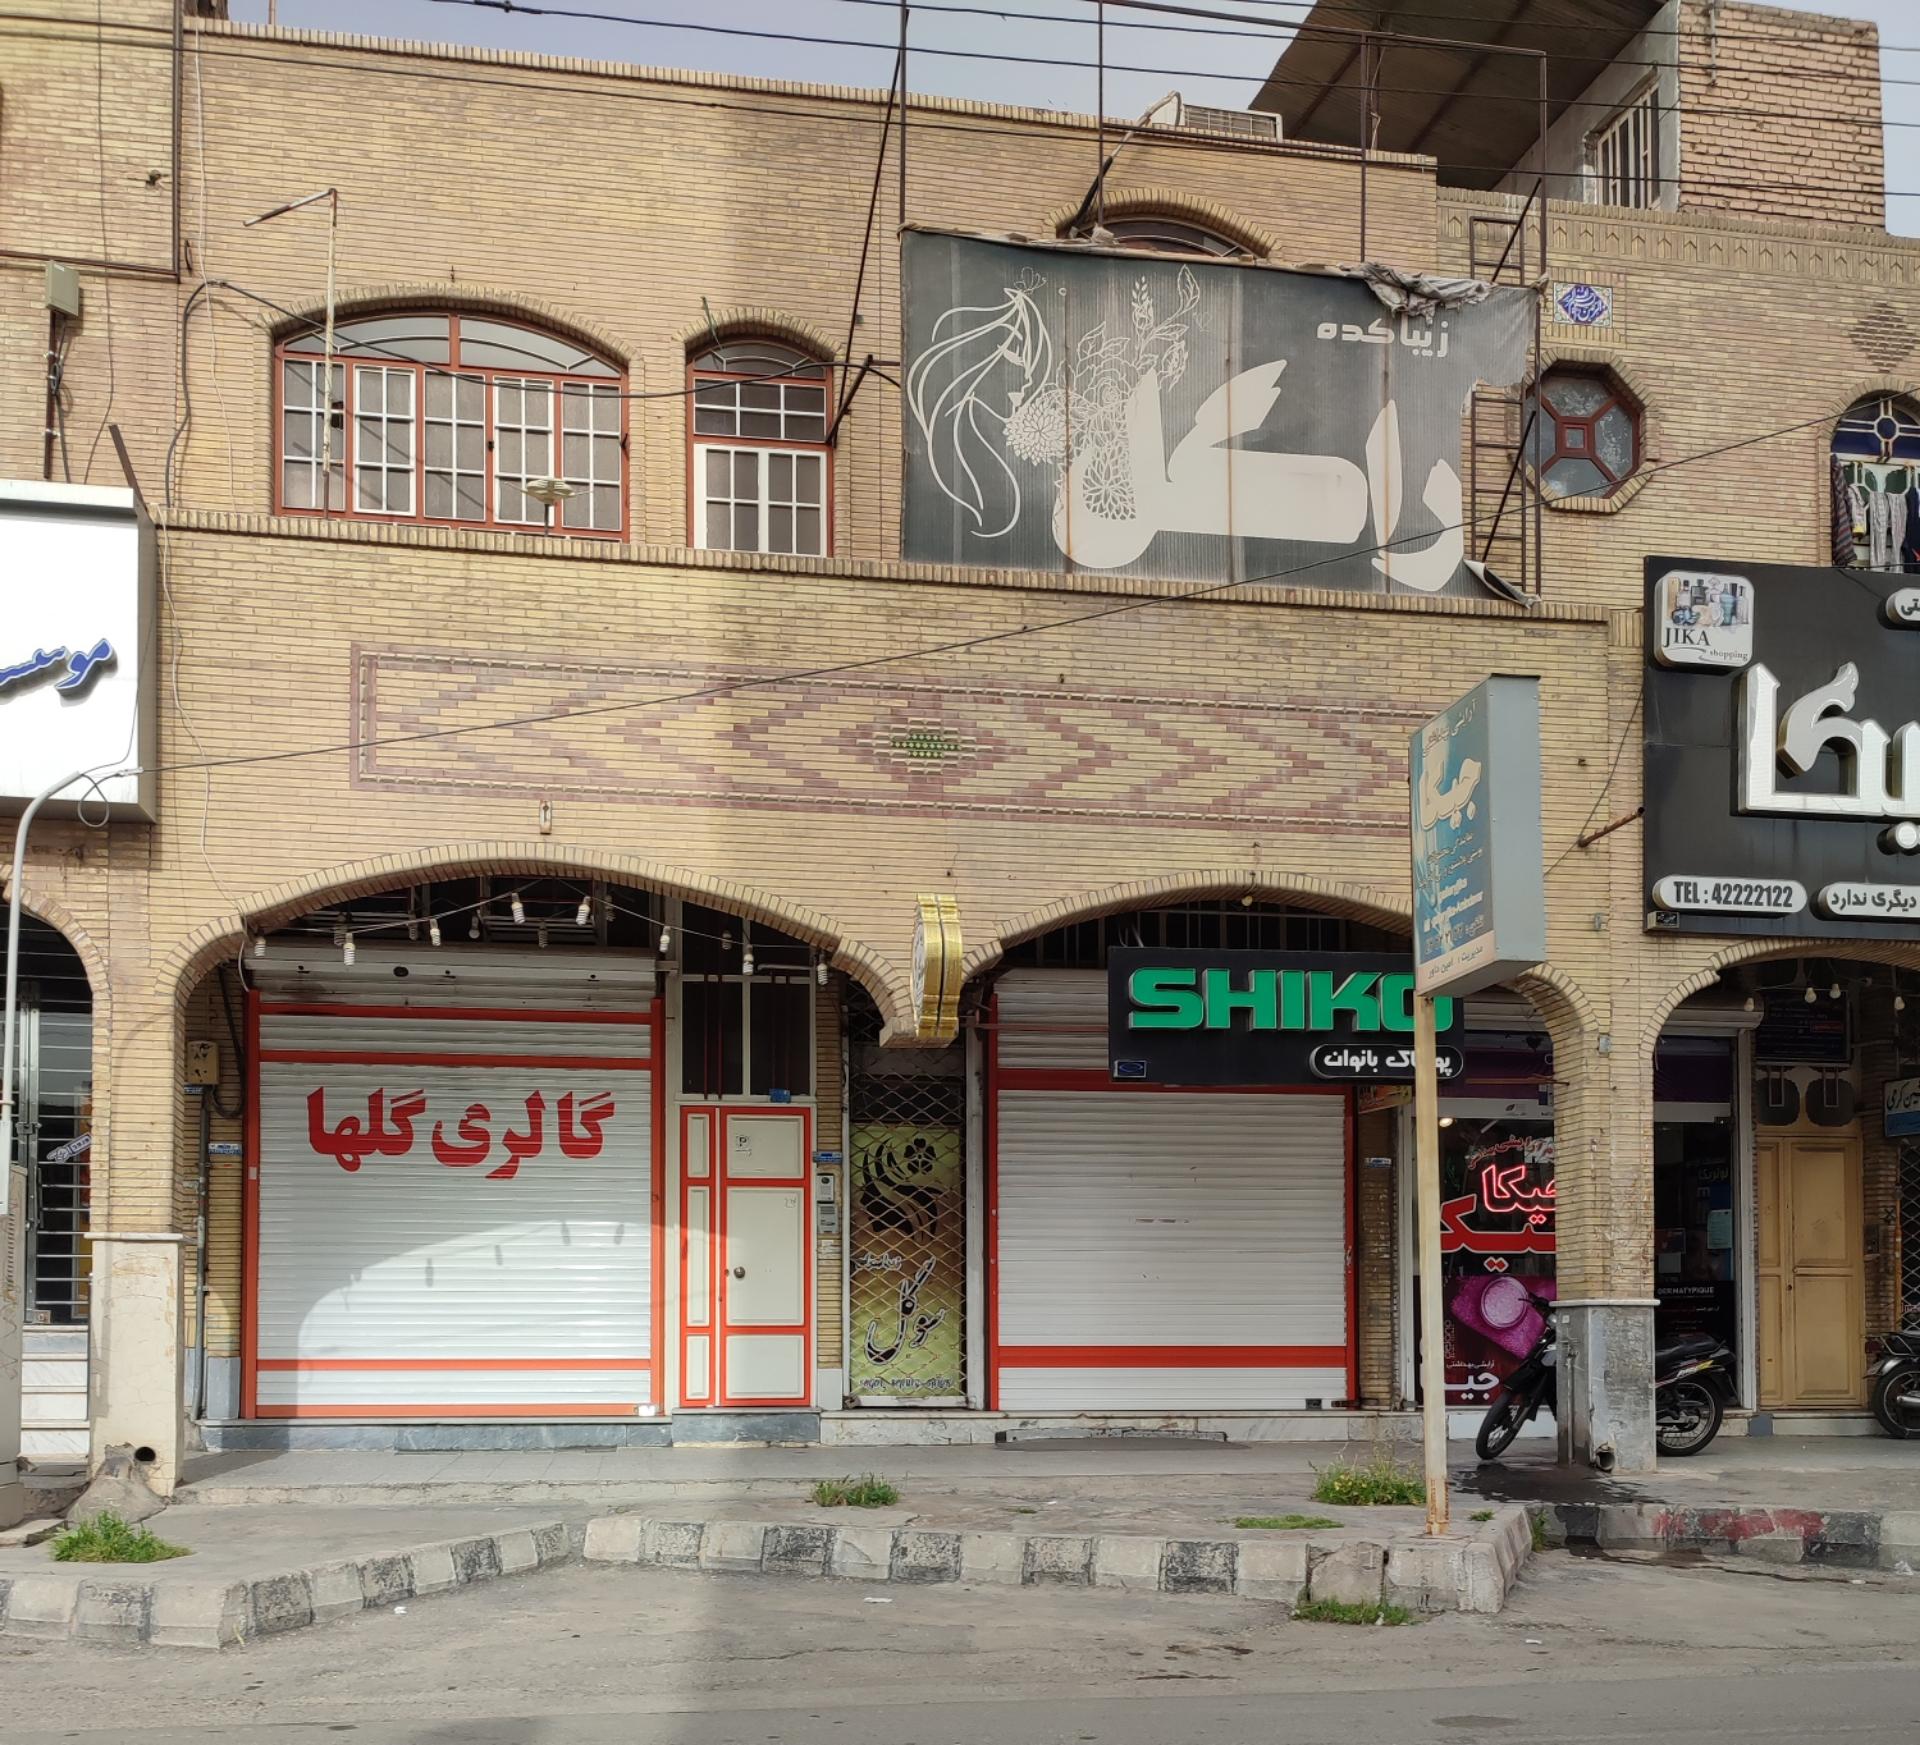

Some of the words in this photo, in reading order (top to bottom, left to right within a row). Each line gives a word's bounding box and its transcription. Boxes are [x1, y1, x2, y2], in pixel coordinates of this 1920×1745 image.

[1316, 312, 1450, 358] زیباکده
[1664, 626, 1711, 649] JIKA
[1709, 648, 1749, 661] shopping
[1419, 758, 1482, 832] جیکا
[1712, 882, 1793, 907] 42222122
[1831, 889, 1867, 910] ندارد
[1871, 889, 1918, 913] دیگری
[1323, 1050, 1378, 1073] بانوان
[1386, 1050, 1452, 1076] پواک
[306, 1086, 427, 1173] گلها
[431, 1089, 616, 1180] گالری
